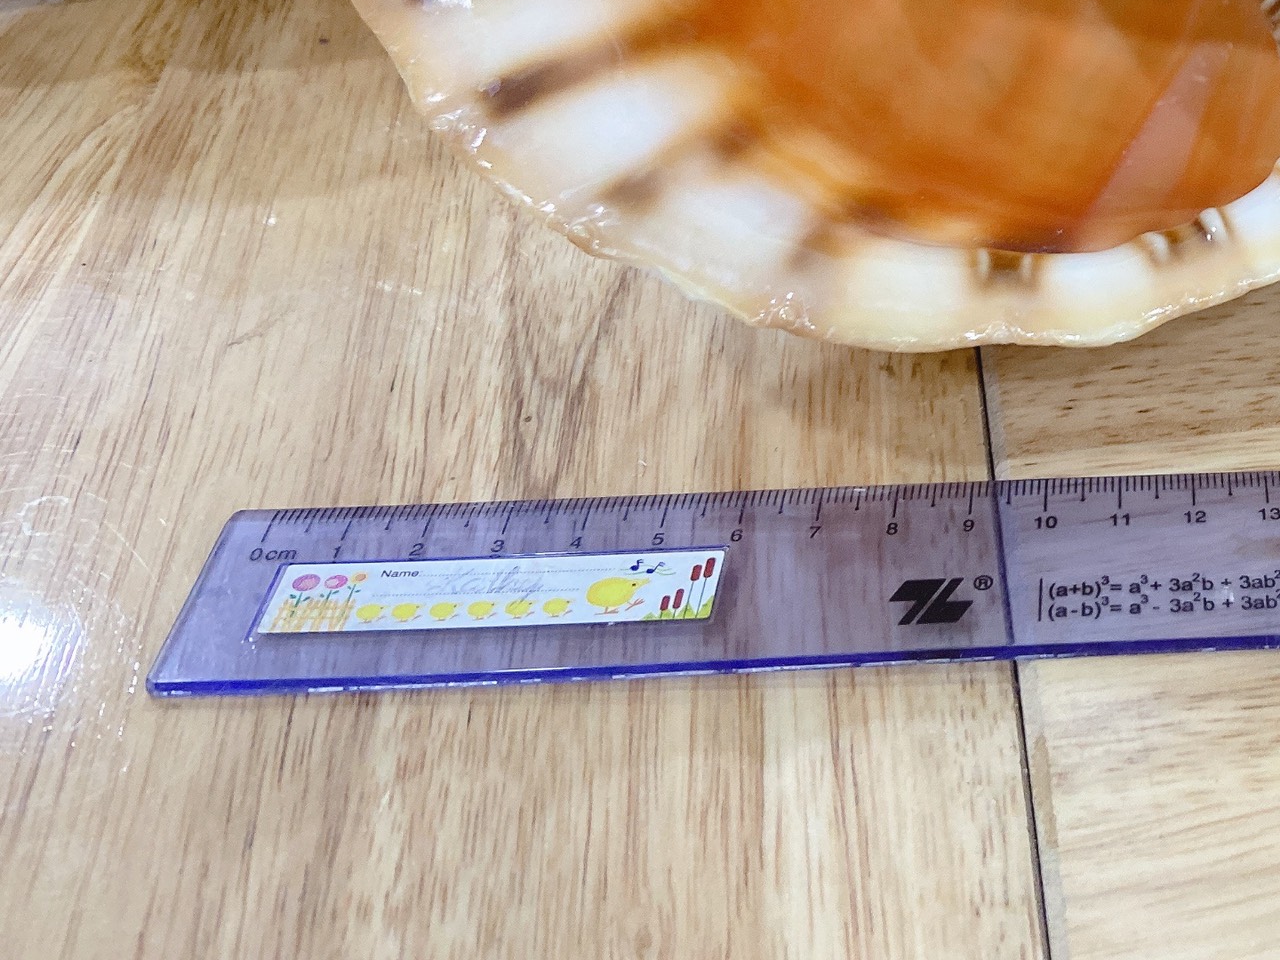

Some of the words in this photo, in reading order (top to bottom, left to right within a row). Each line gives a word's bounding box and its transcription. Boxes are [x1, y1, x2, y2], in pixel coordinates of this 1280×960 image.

[410, 543, 424, 557] 2
[490, 540, 504, 553] 3
[570, 536, 582, 549] 4
[652, 533, 664, 546] 5
[730, 529, 743, 542] 6
[809, 526, 822, 539] 7
[886, 523, 898, 535] 8
[963, 519, 975, 532] 9
[1034, 516, 1058, 529] 10
[1109, 513, 1131, 526] 11
[1183, 510, 1207, 523] 12
[380, 569, 420, 579] Name
